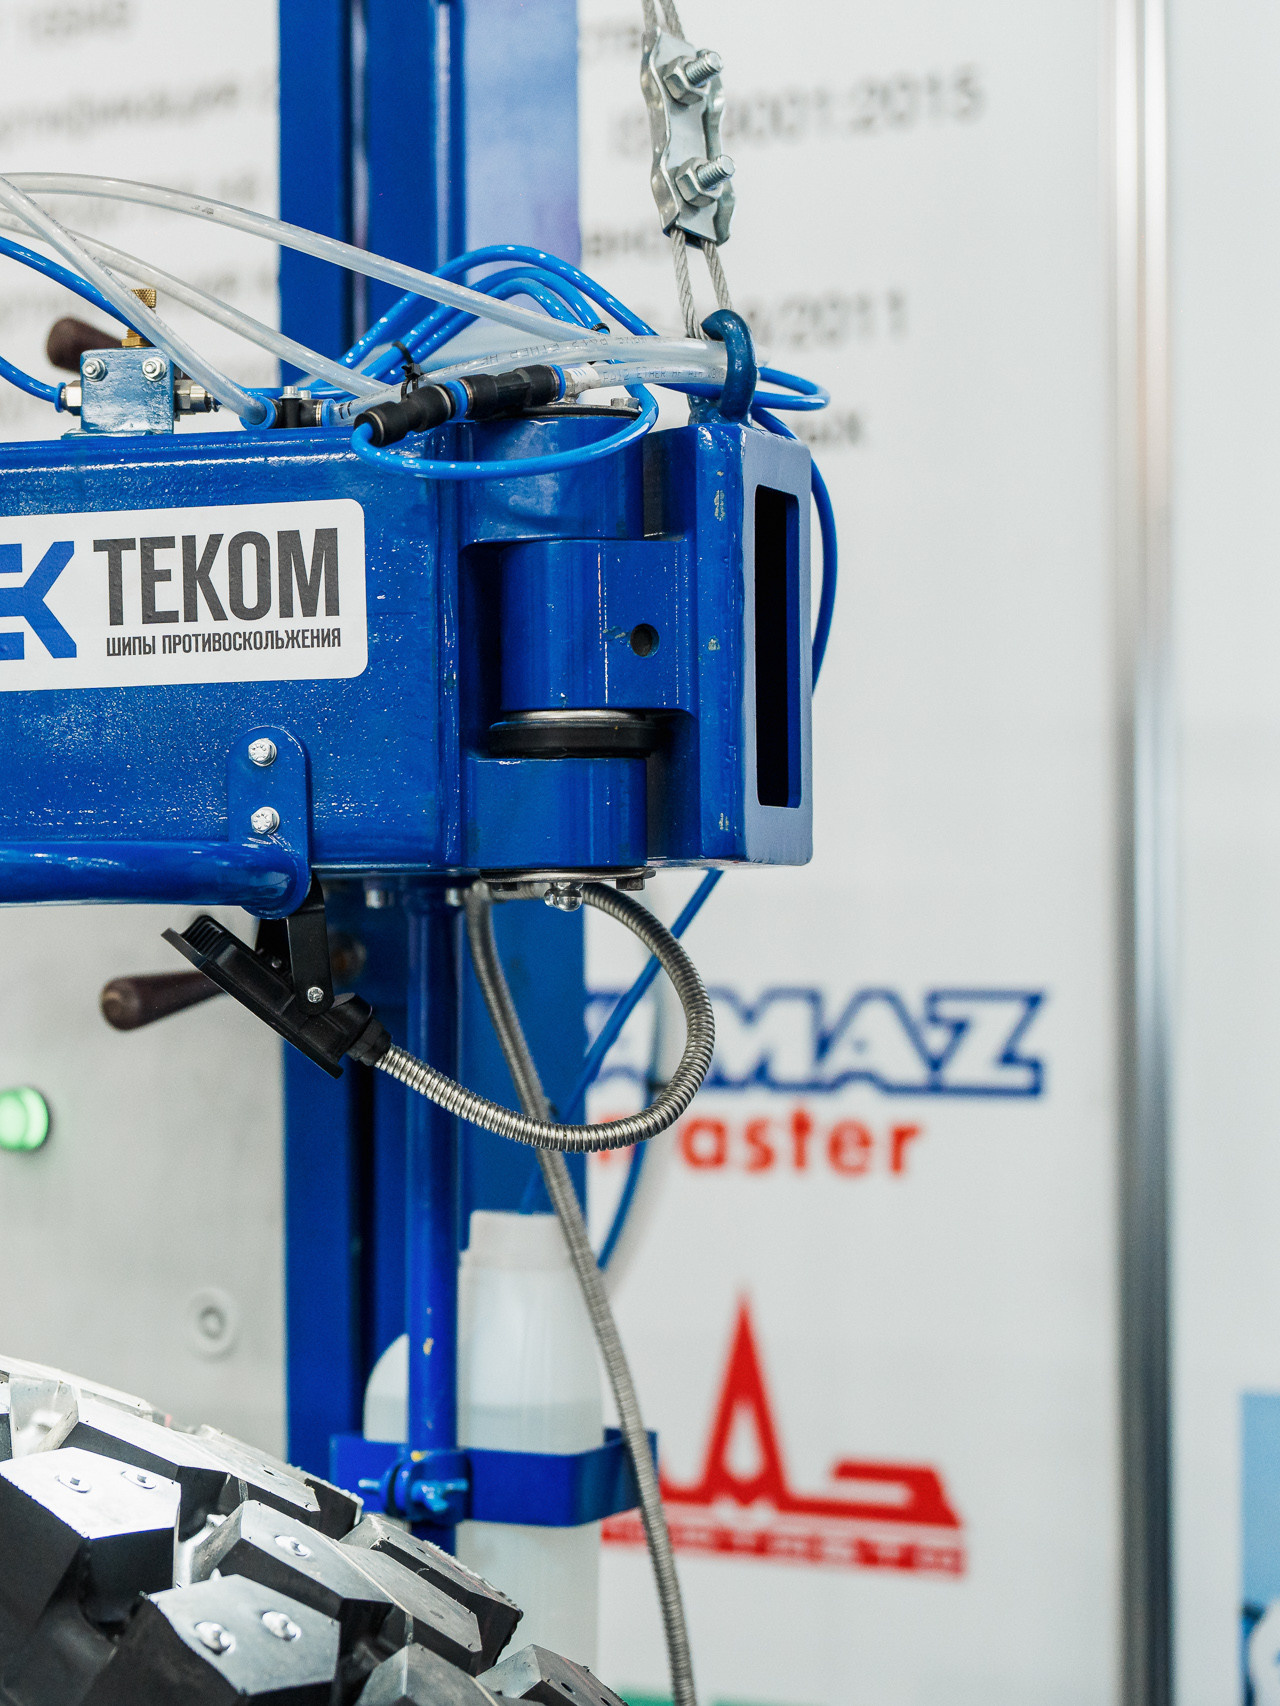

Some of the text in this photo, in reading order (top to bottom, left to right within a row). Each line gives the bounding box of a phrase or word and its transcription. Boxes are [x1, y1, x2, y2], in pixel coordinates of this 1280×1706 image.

[106, 627, 342, 657] ШИПЫ ПРОТИВОСКОЛЬЖЕНИЯ
[591, 1104, 923, 1174] aster
